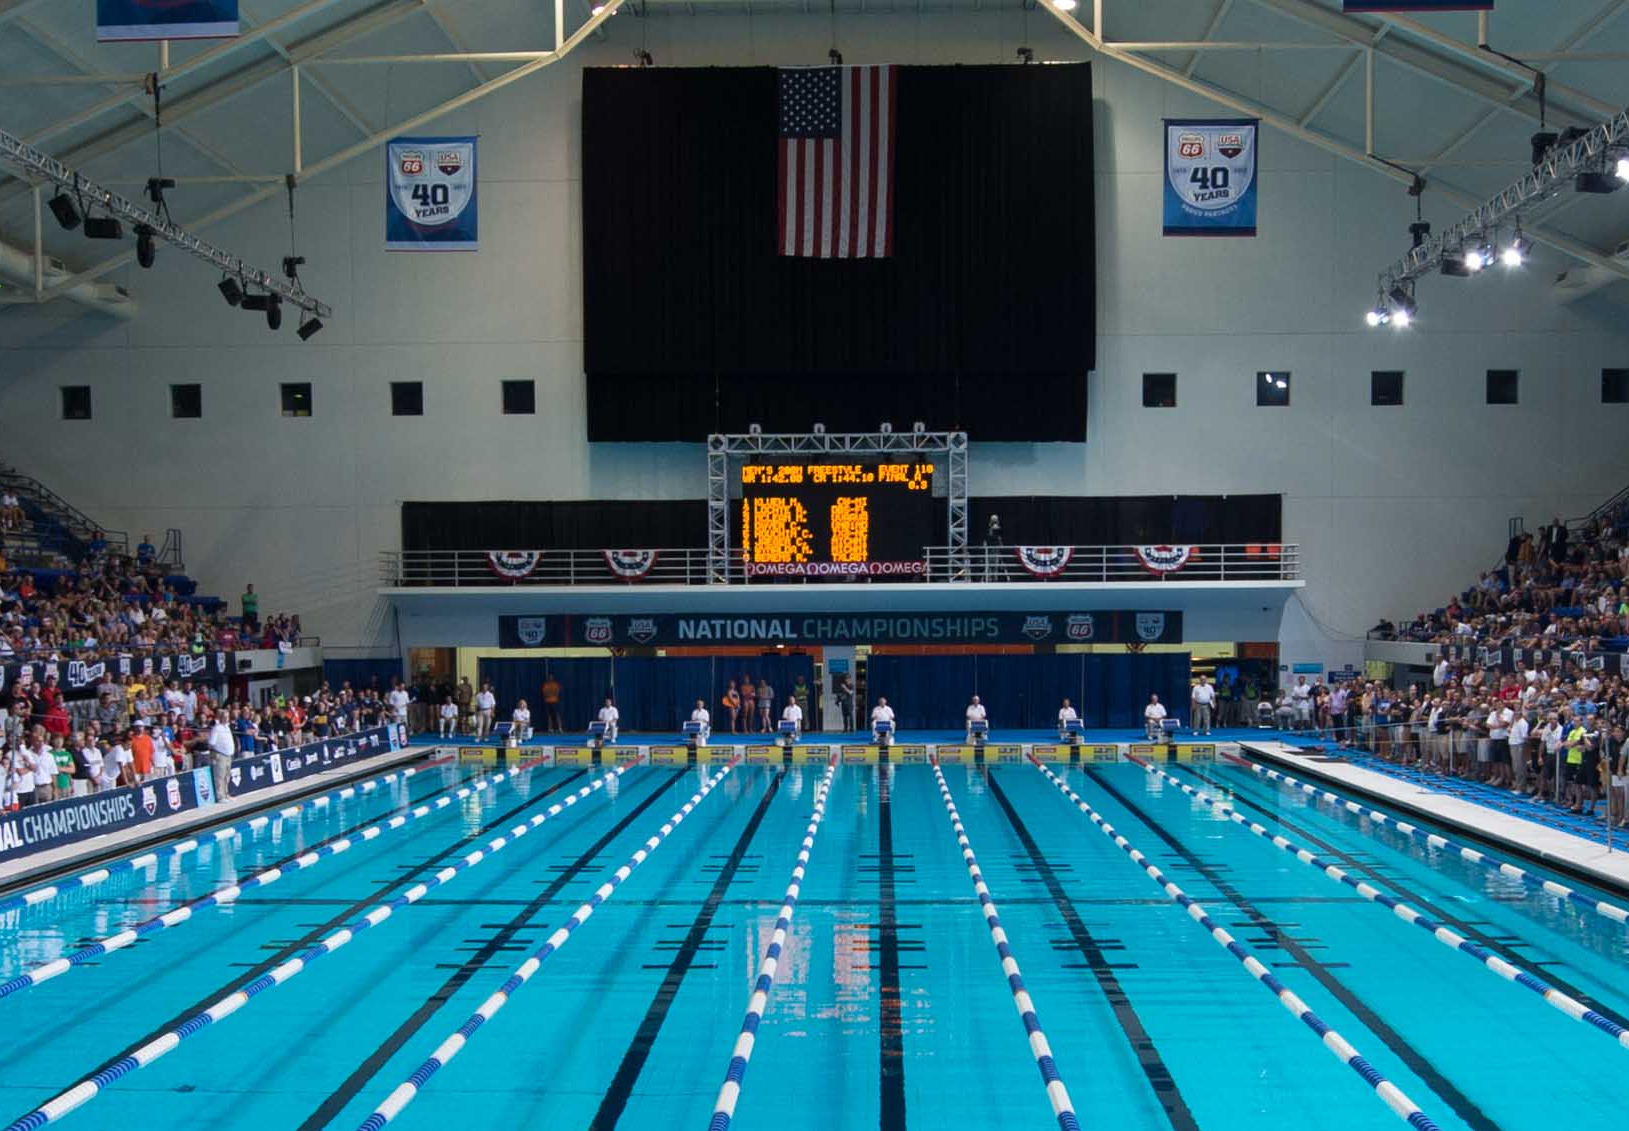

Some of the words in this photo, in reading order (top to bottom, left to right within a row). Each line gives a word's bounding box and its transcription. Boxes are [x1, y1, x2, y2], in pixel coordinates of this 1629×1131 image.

[1182, 144, 1200, 155] 66
[402, 161, 421, 172] 66
[1190, 167, 1229, 190] 40
[411, 183, 449, 206] 40
[1193, 189, 1230, 201] YEARS
[414, 206, 450, 218] YEARS
[756, 564, 806, 574] OMEGA
[819, 563, 868, 574] OMEGA
[883, 562, 931, 573] OMEGA
[590, 629, 608, 640] 66
[678, 618, 798, 640] NATIONAL
[802, 617, 1000, 640] CHAMPIONSHIPS
[1071, 625, 1089, 635] 66
[23, 793, 136, 845] CHAMPIONSHIPS
